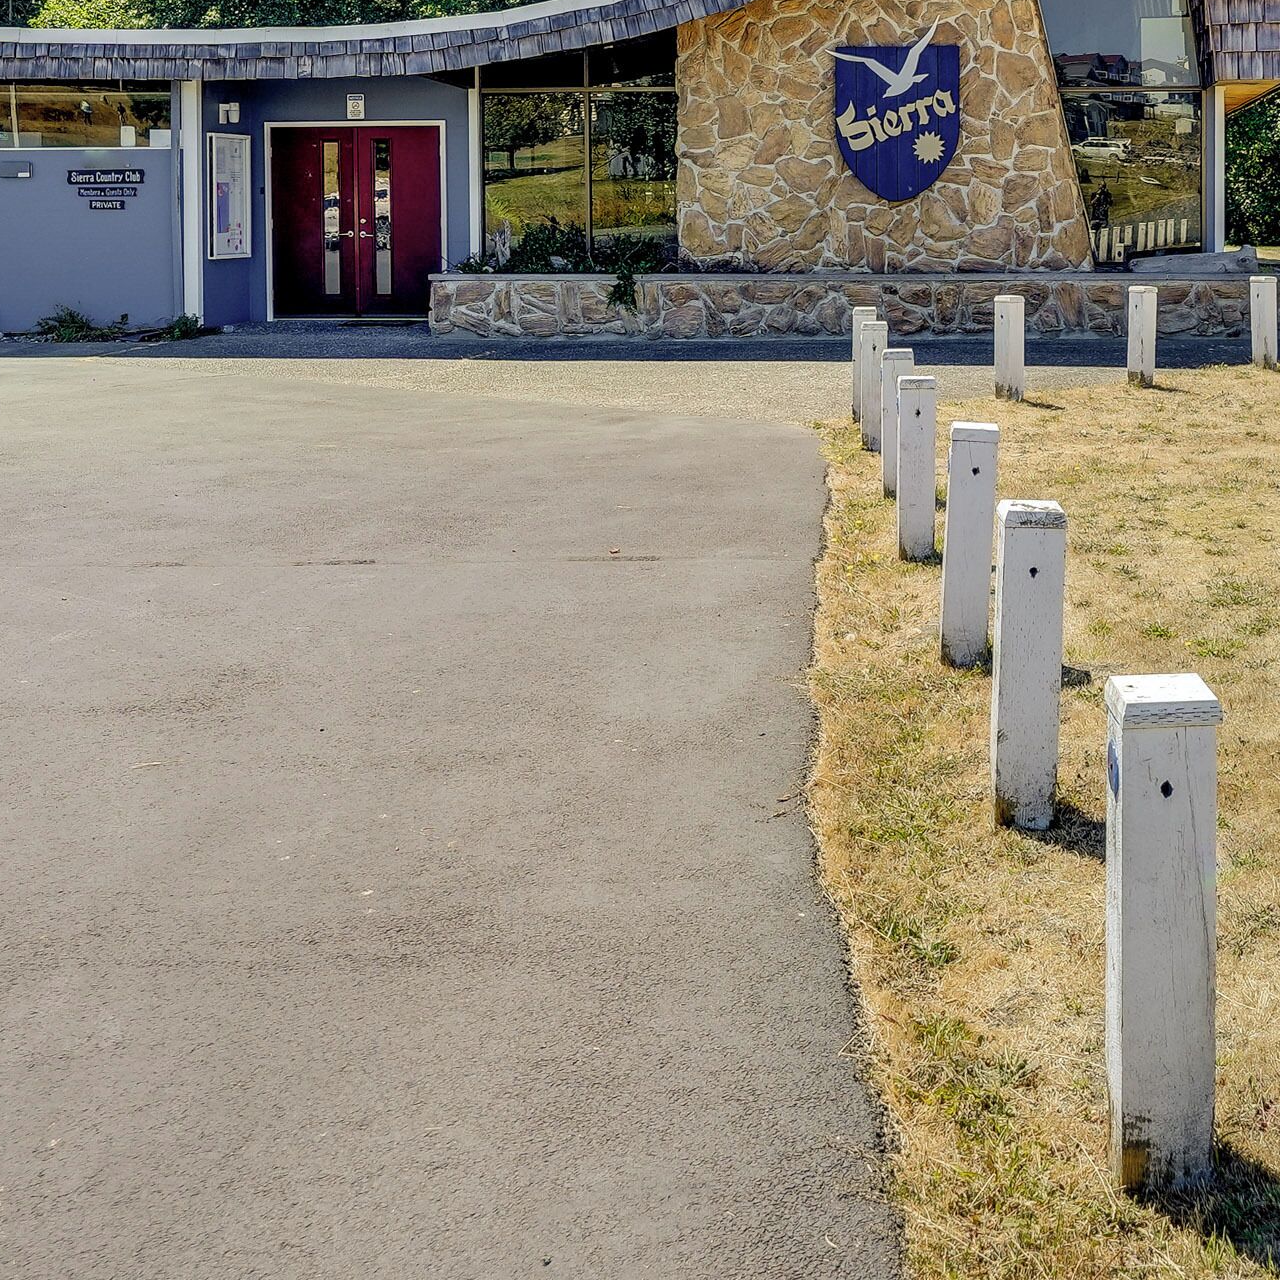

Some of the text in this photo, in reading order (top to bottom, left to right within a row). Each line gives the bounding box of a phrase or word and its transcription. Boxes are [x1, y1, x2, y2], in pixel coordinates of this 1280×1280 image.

[836, 89, 956, 151] Sierra
[70, 171, 141, 183] Sierra Country Club
[105, 188, 122, 196] Guests
[123, 188, 135, 196] Only
[91, 201, 121, 209] PRIVATE
